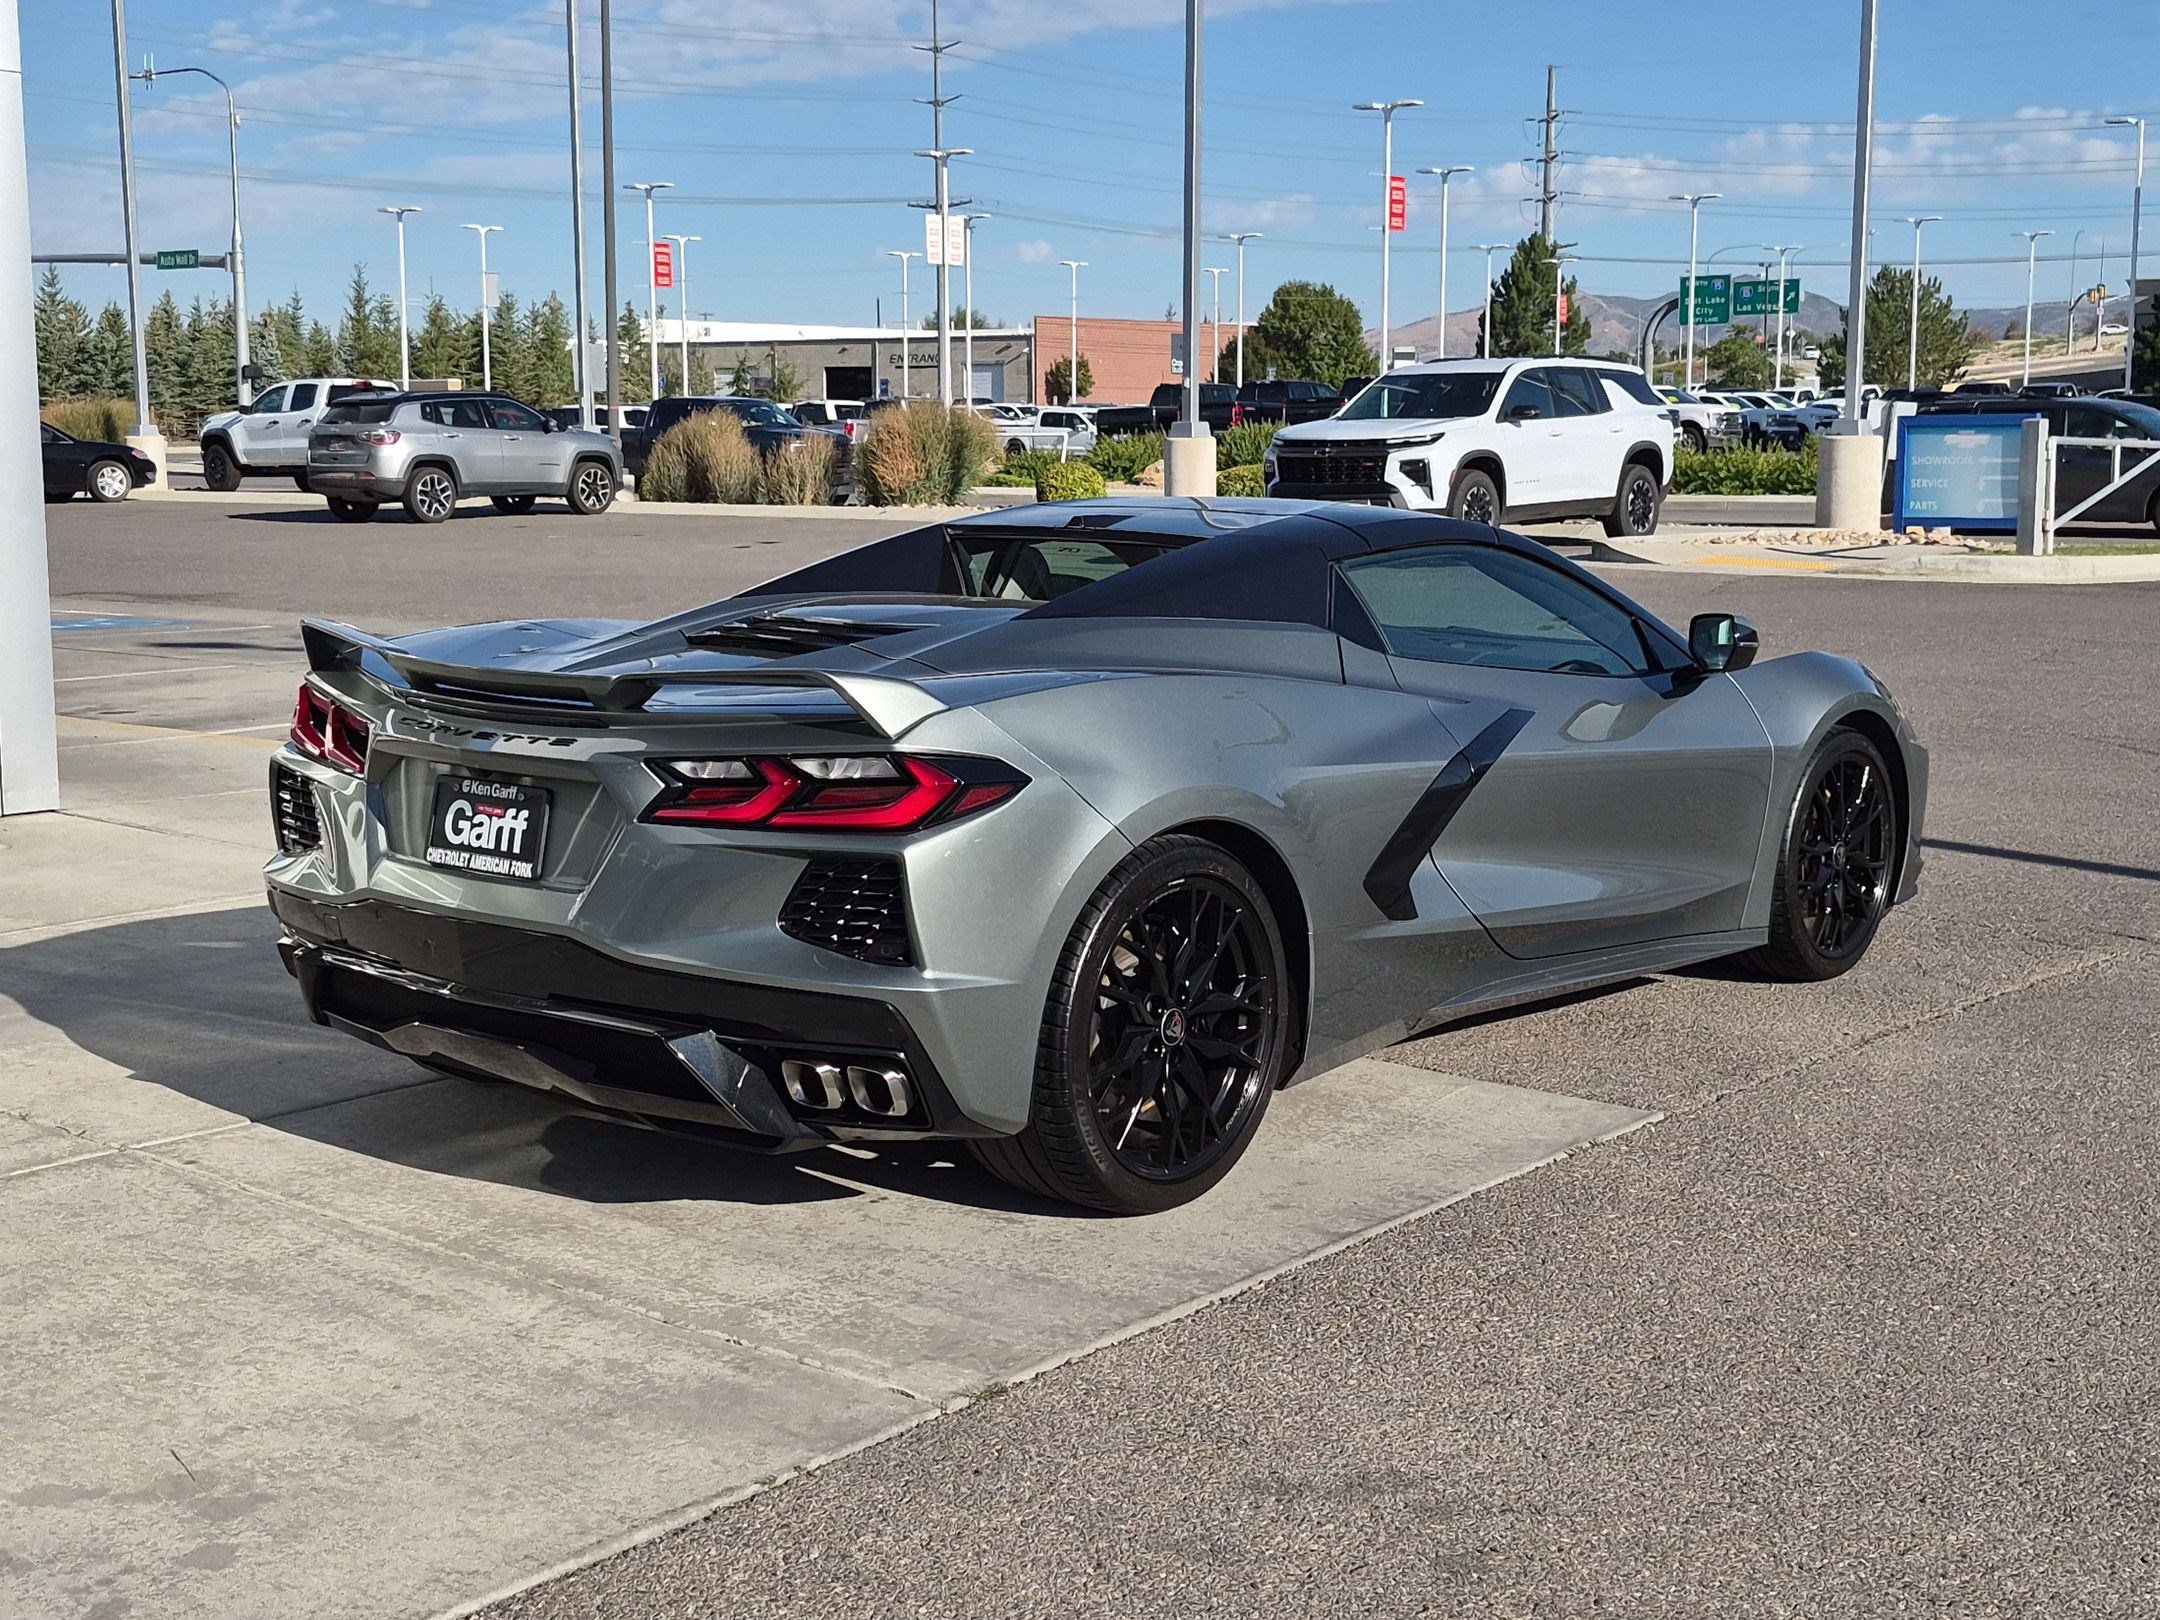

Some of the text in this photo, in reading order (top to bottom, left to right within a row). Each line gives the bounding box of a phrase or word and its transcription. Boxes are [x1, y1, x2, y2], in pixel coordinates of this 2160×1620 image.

[160, 254, 196, 266] Auto Mall Dr
[1686, 280, 1708, 288] NRTH
[1685, 296, 1726, 305] Slt Lake
[1695, 307, 1713, 316] City
[1756, 303, 1781, 312] Vega
[889, 353, 939, 364] ENTRANC
[1911, 456, 1974, 466] SHOWROOM
[1910, 479, 1949, 489] SERVICE
[1909, 500, 1938, 511] PARTS
[400, 717, 578, 748] CORVETTE
[491, 783, 518, 800] Garff
[444, 799, 529, 855] Garff
[426, 847, 533, 878] CHEVROLET AMERICAN FORK
